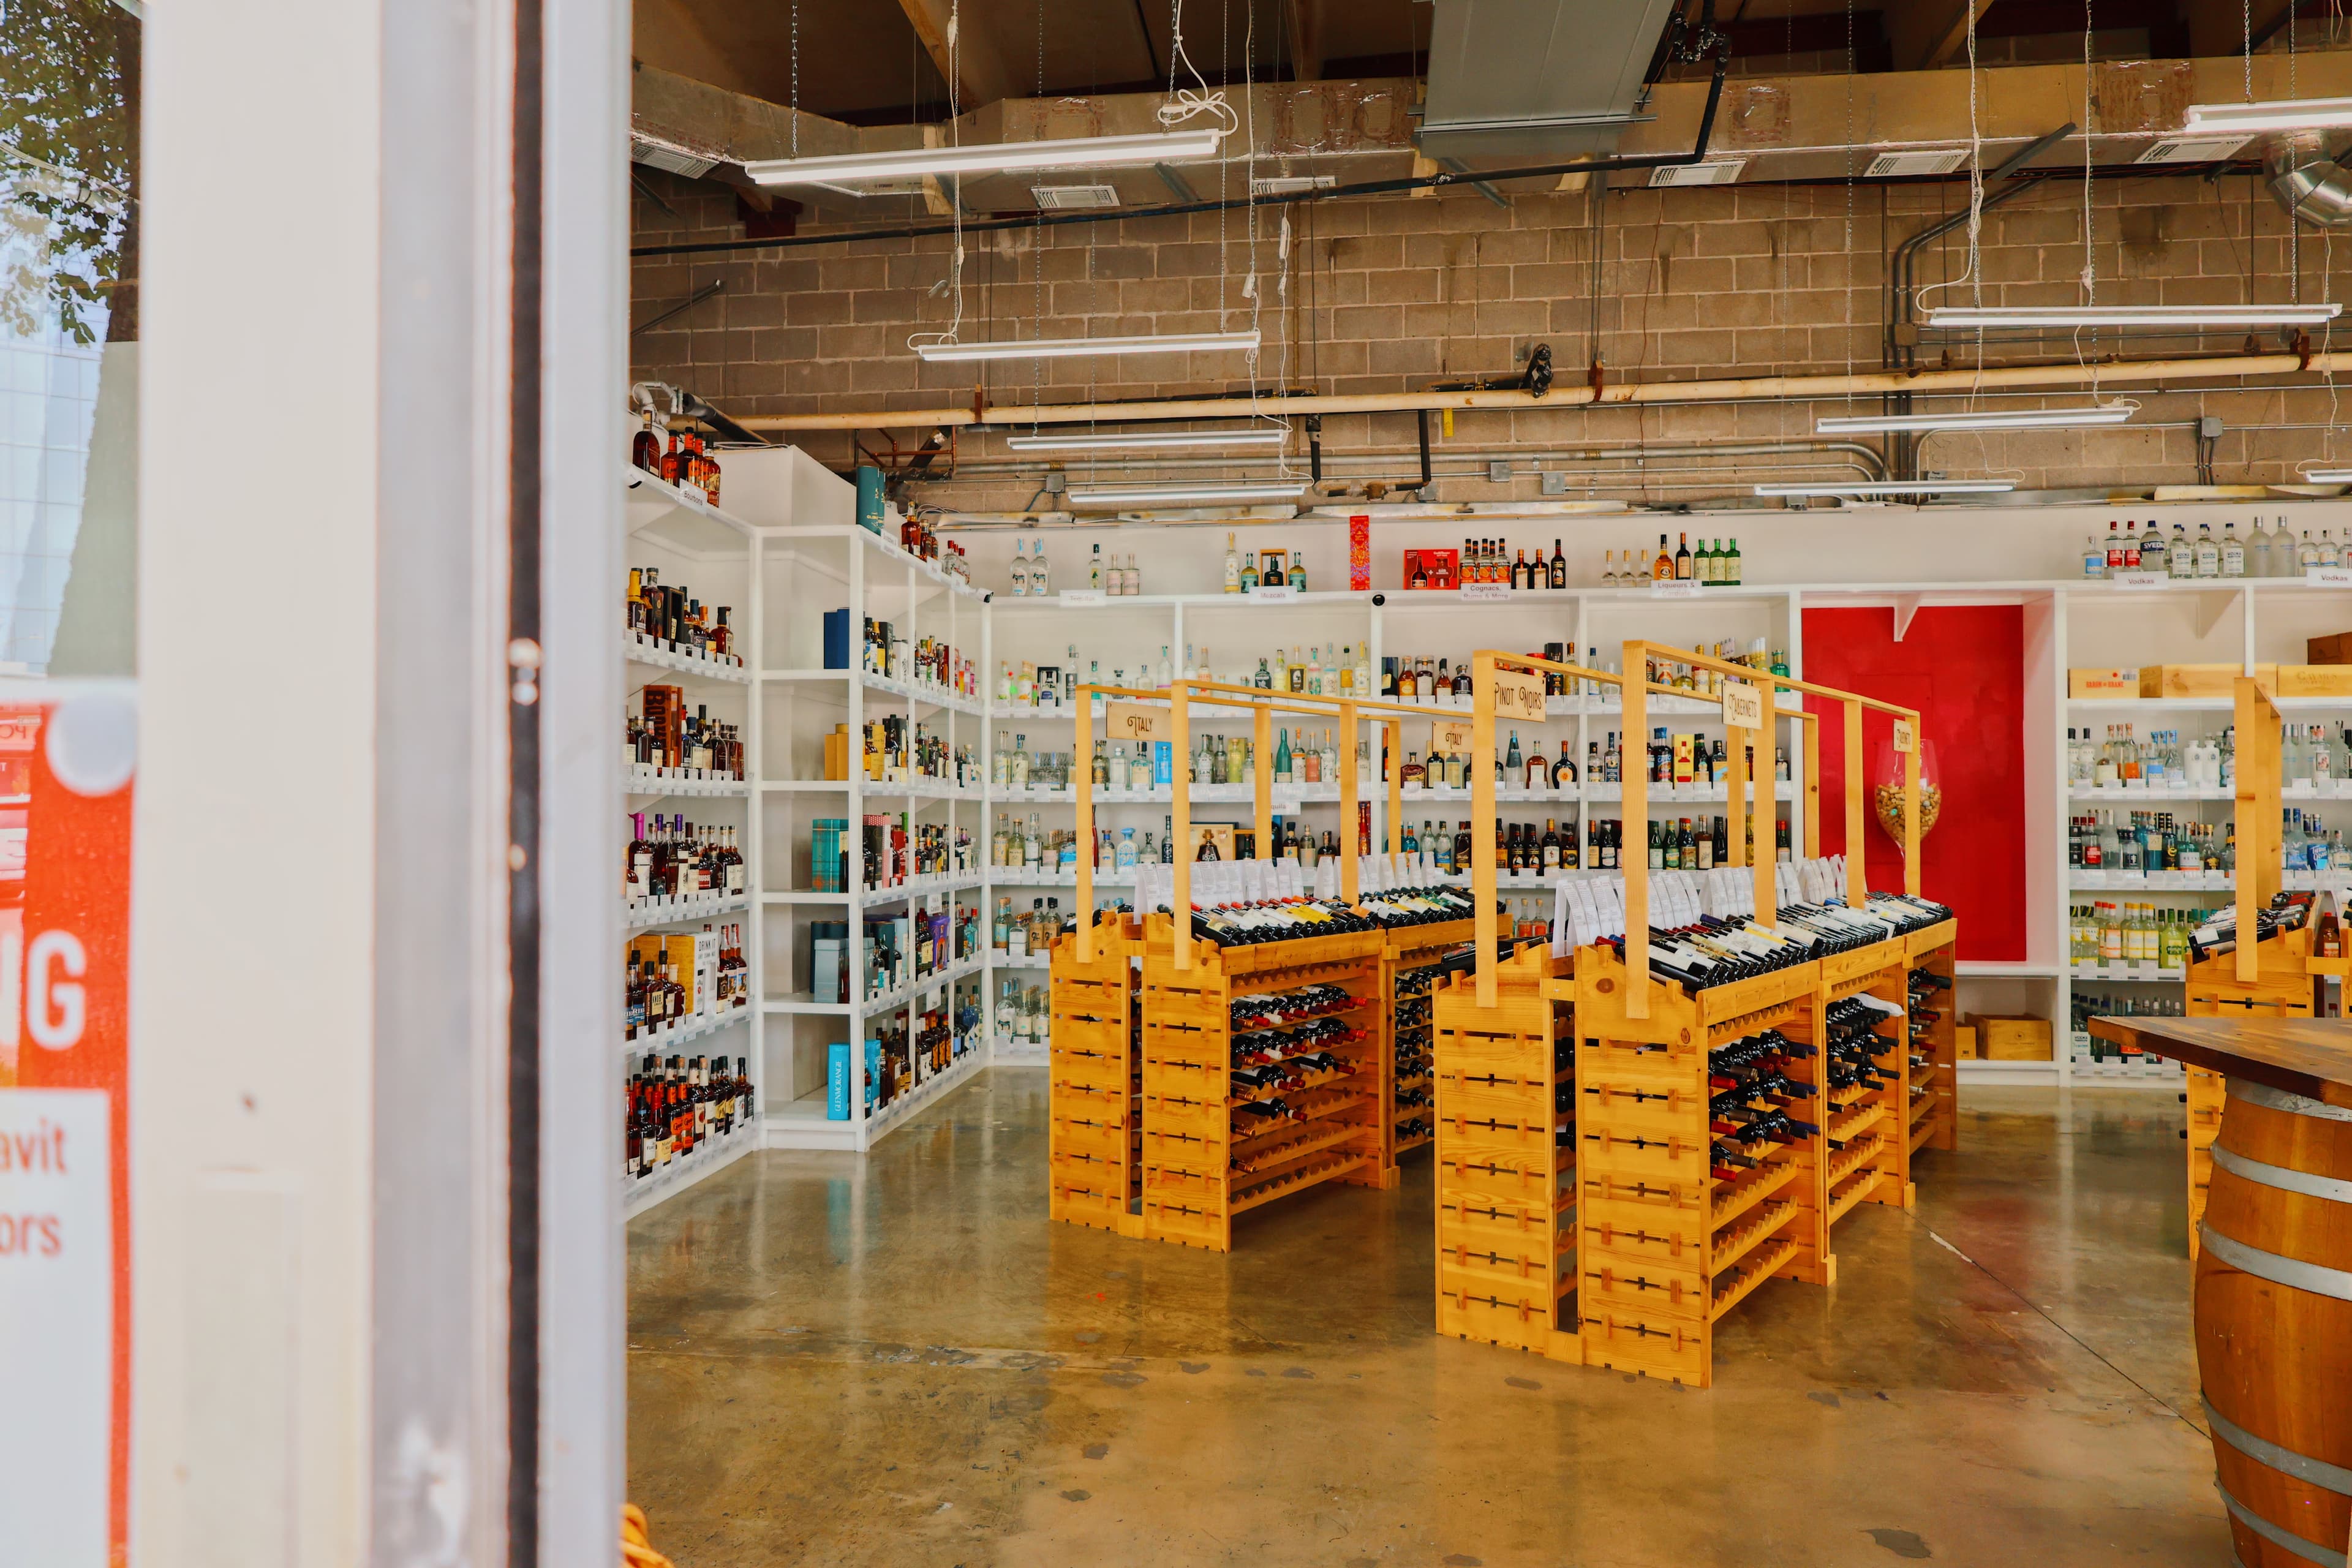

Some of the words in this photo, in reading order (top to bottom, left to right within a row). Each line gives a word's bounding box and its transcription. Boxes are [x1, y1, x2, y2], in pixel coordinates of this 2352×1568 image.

[684, 491, 703, 507] Bourbons
[1494, 681, 1514, 710] PINOT
[1519, 685, 1542, 716] NOIRS
[1728, 693, 1757, 720] CABERNETS
[1127, 713, 1153, 736] ITALY
[1446, 730, 1463, 749] ITALY
